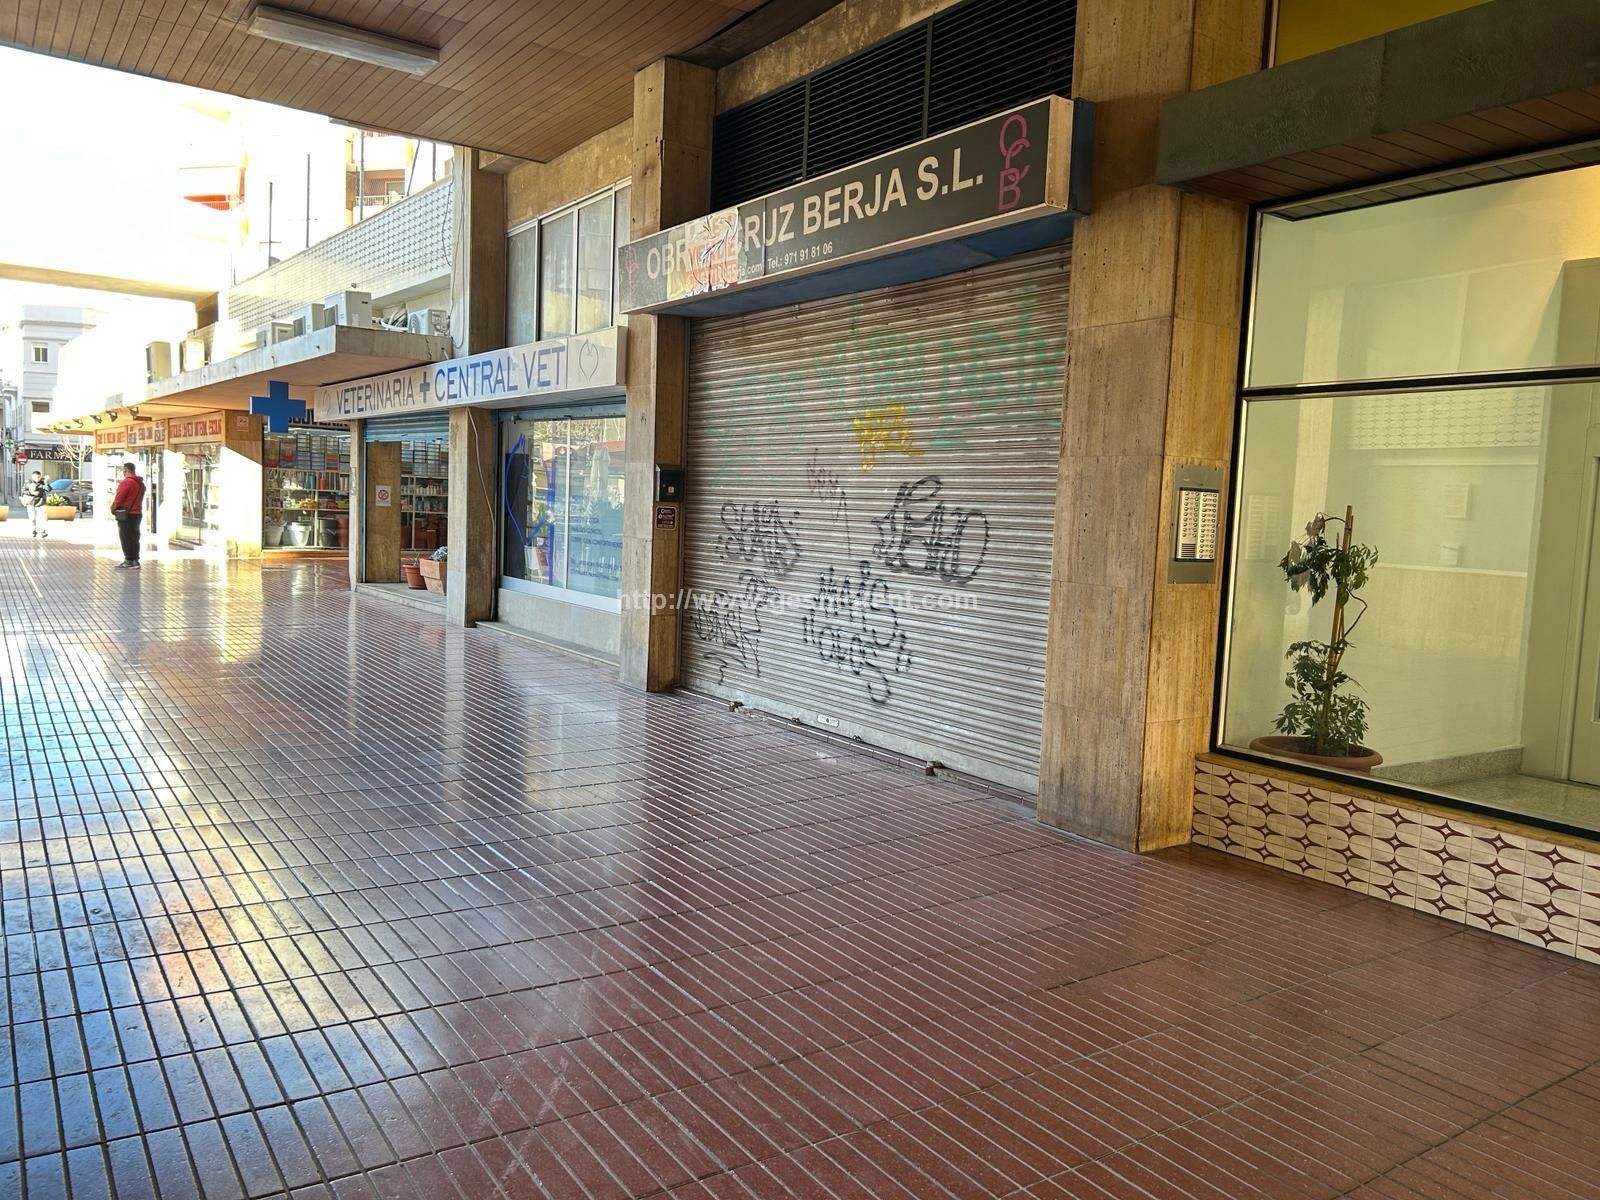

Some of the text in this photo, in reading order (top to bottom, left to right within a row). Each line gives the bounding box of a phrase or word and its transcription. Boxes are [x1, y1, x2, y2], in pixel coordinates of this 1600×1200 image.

[738, 202, 795, 255] RUZ
[803, 166, 908, 237] BERJA
[916, 146, 985, 203] S.L.
[784, 250, 798, 265] 971
[799, 247, 810, 261] 91
[811, 244, 821, 259] 81
[822, 241, 833, 255] 06
[335, 346, 567, 415] VETERINARIA CENTRAL VET
